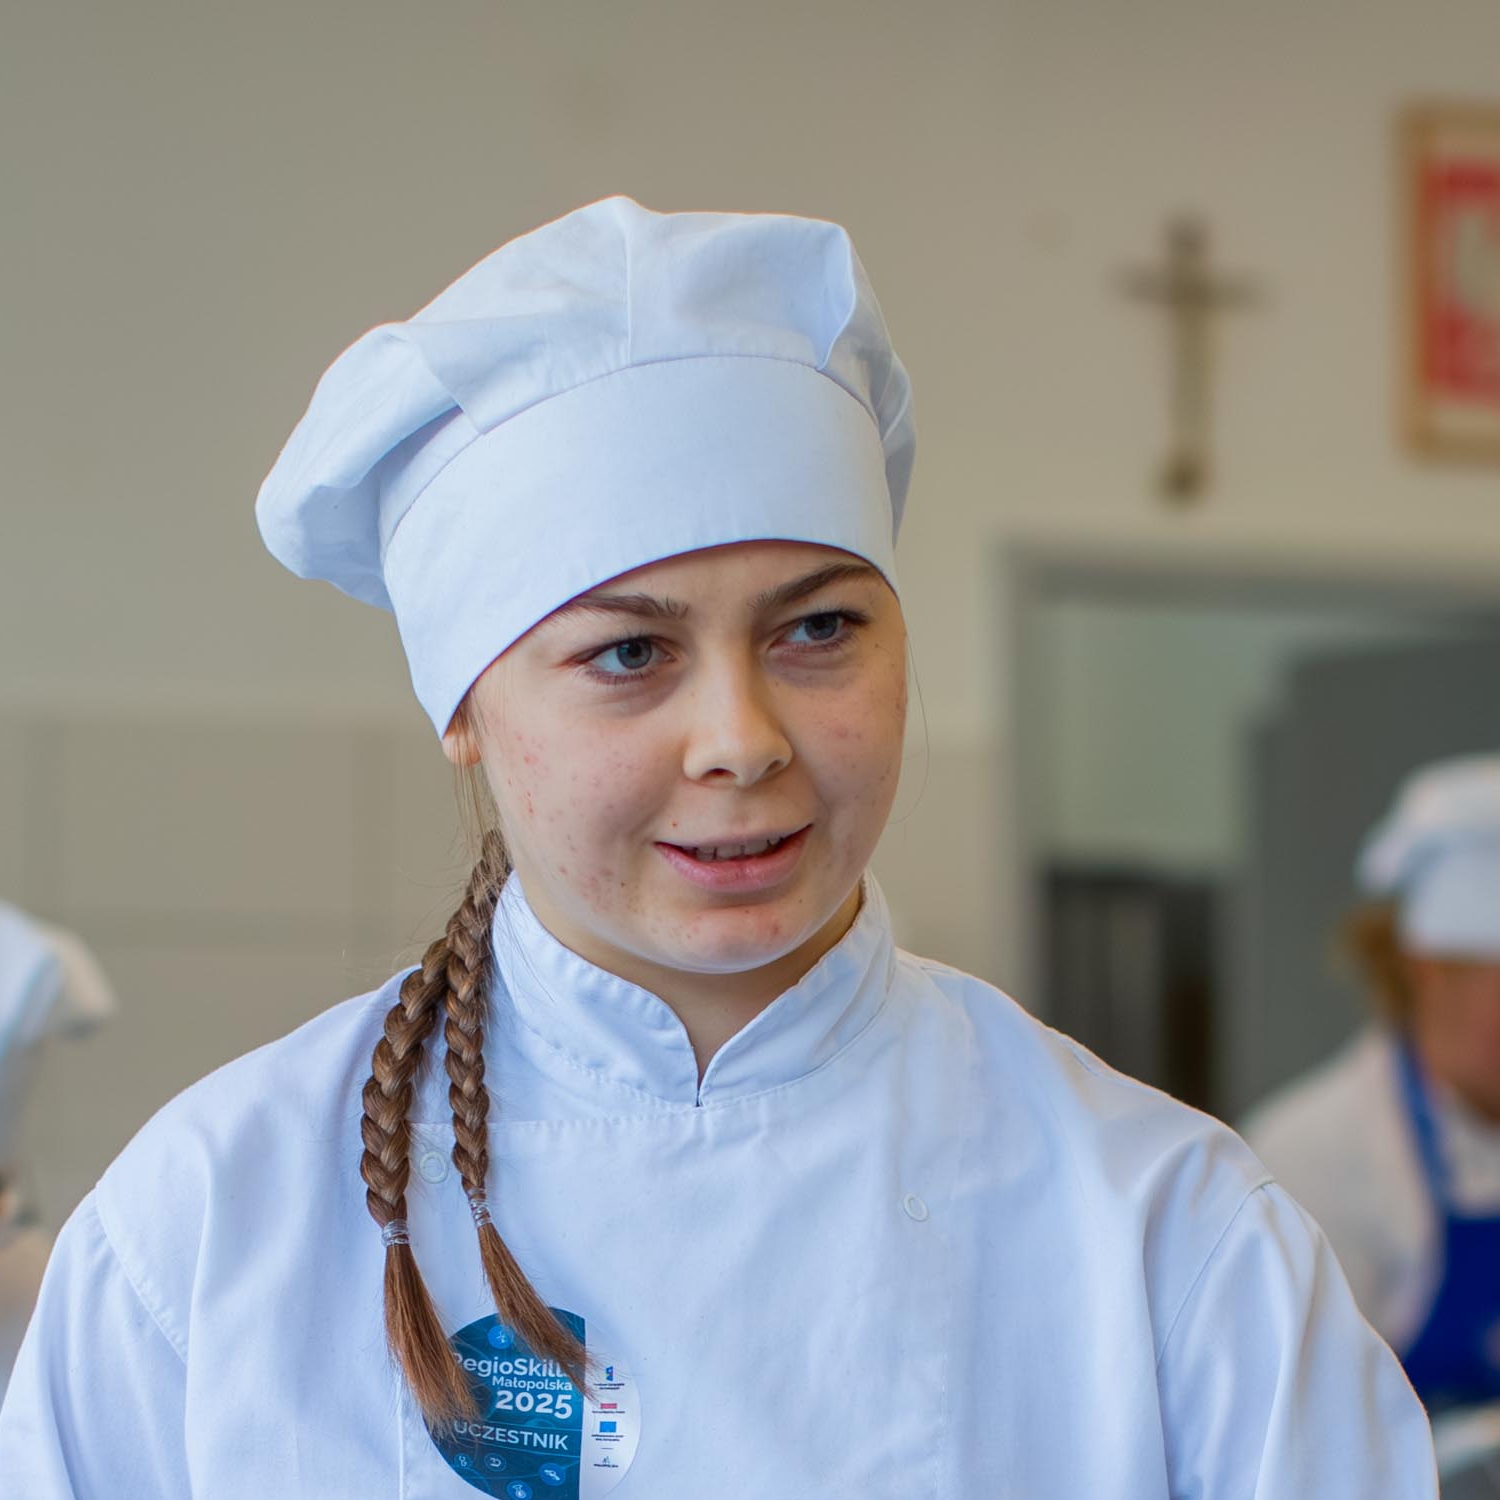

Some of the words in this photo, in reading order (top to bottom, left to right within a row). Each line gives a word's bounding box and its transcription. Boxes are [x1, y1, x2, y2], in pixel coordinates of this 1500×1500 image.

[451, 1352, 576, 1378] egioSkill
[495, 1391, 573, 1419] 2025
[453, 1420, 569, 1450] UCZESTNIK
